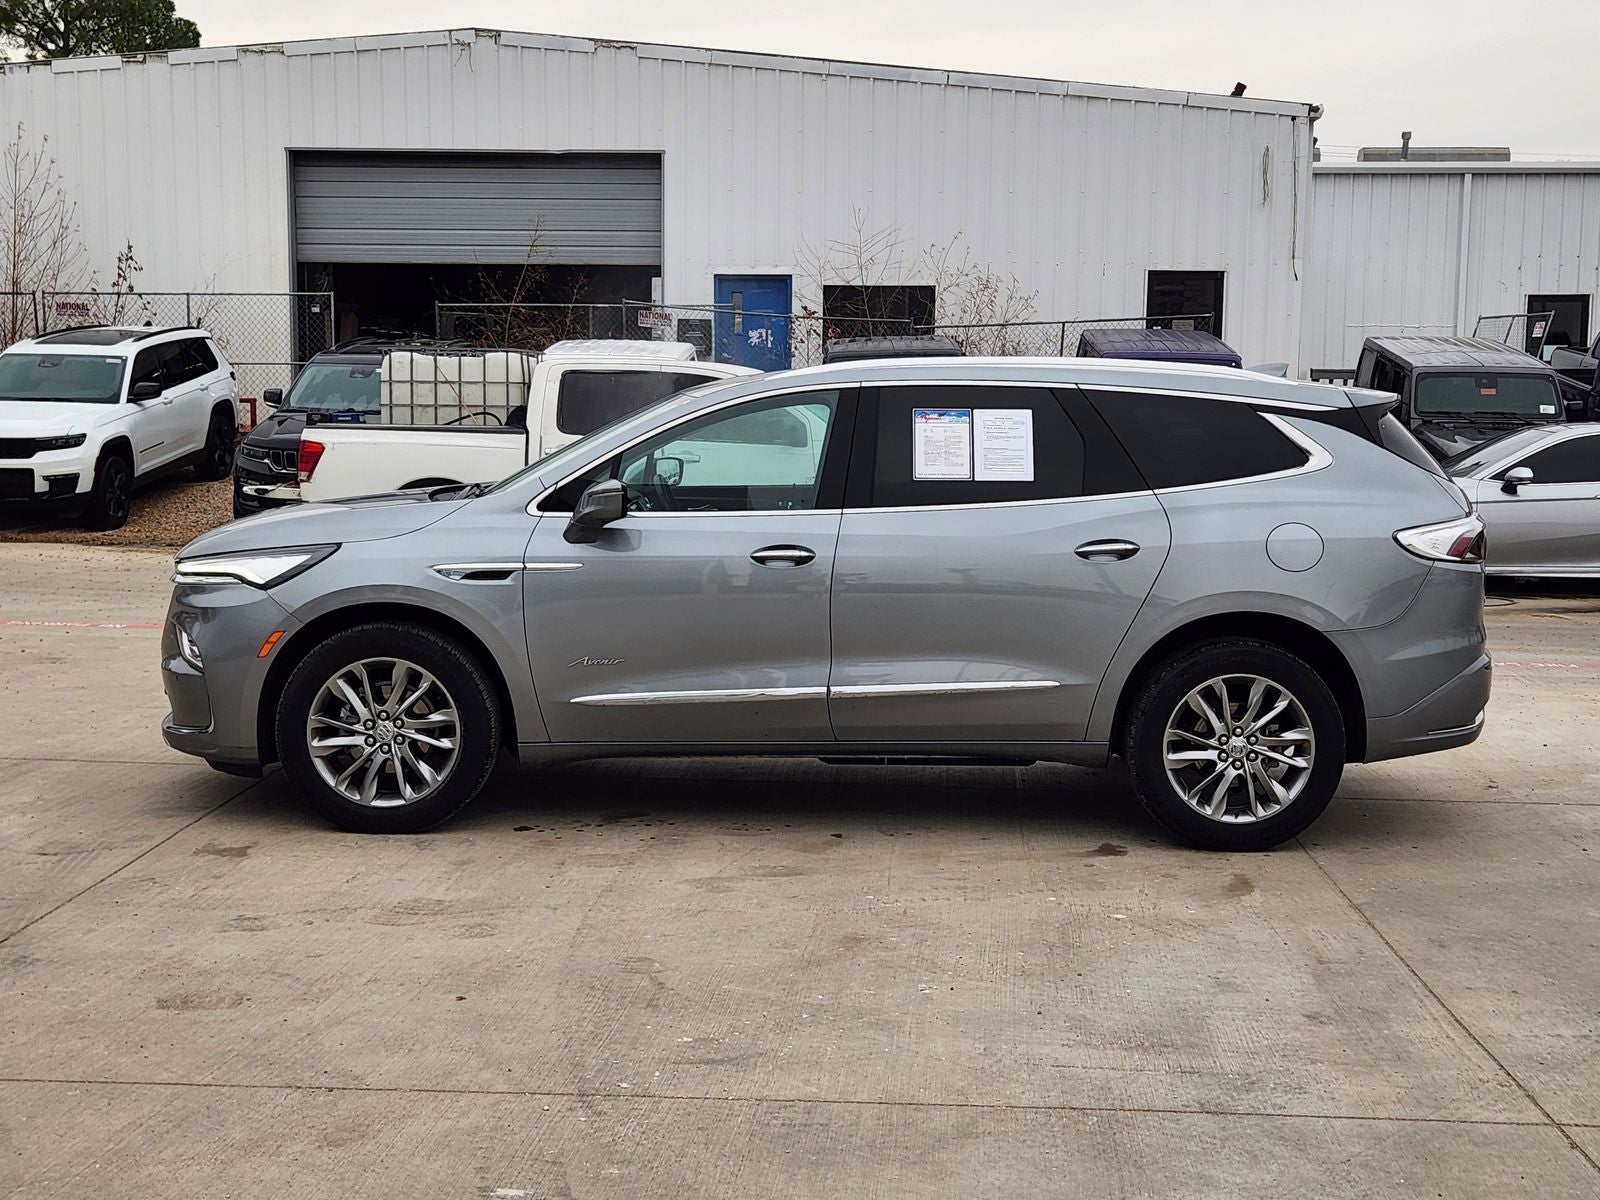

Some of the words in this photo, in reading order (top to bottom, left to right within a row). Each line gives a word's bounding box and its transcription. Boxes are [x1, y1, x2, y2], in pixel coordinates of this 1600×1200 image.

[56, 301, 90, 311] NATIONAL
[640, 311, 672, 321] NATIONAL
[568, 655, 625, 667] Avenir
